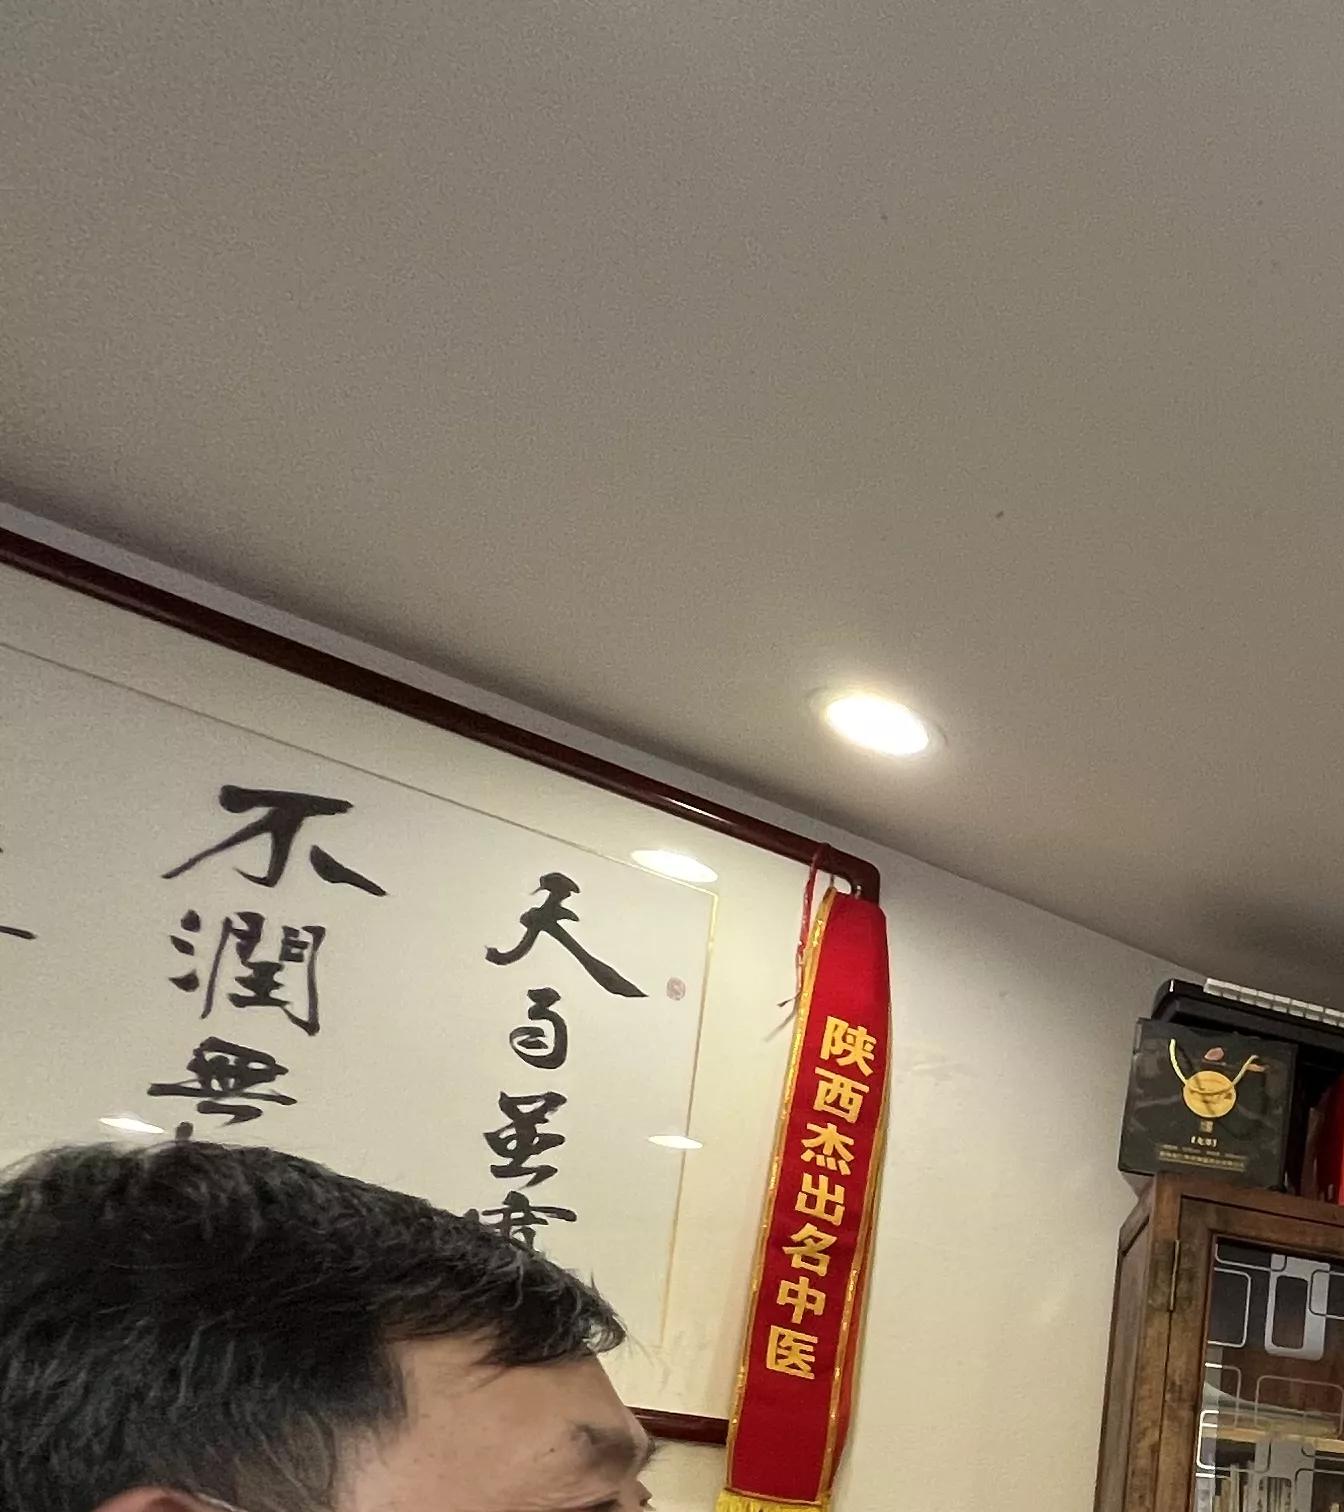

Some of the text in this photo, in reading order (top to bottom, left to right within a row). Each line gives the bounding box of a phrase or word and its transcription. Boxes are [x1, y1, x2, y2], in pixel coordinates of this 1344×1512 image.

[766, 1015, 876, 1381] 陕西杰出名中医
